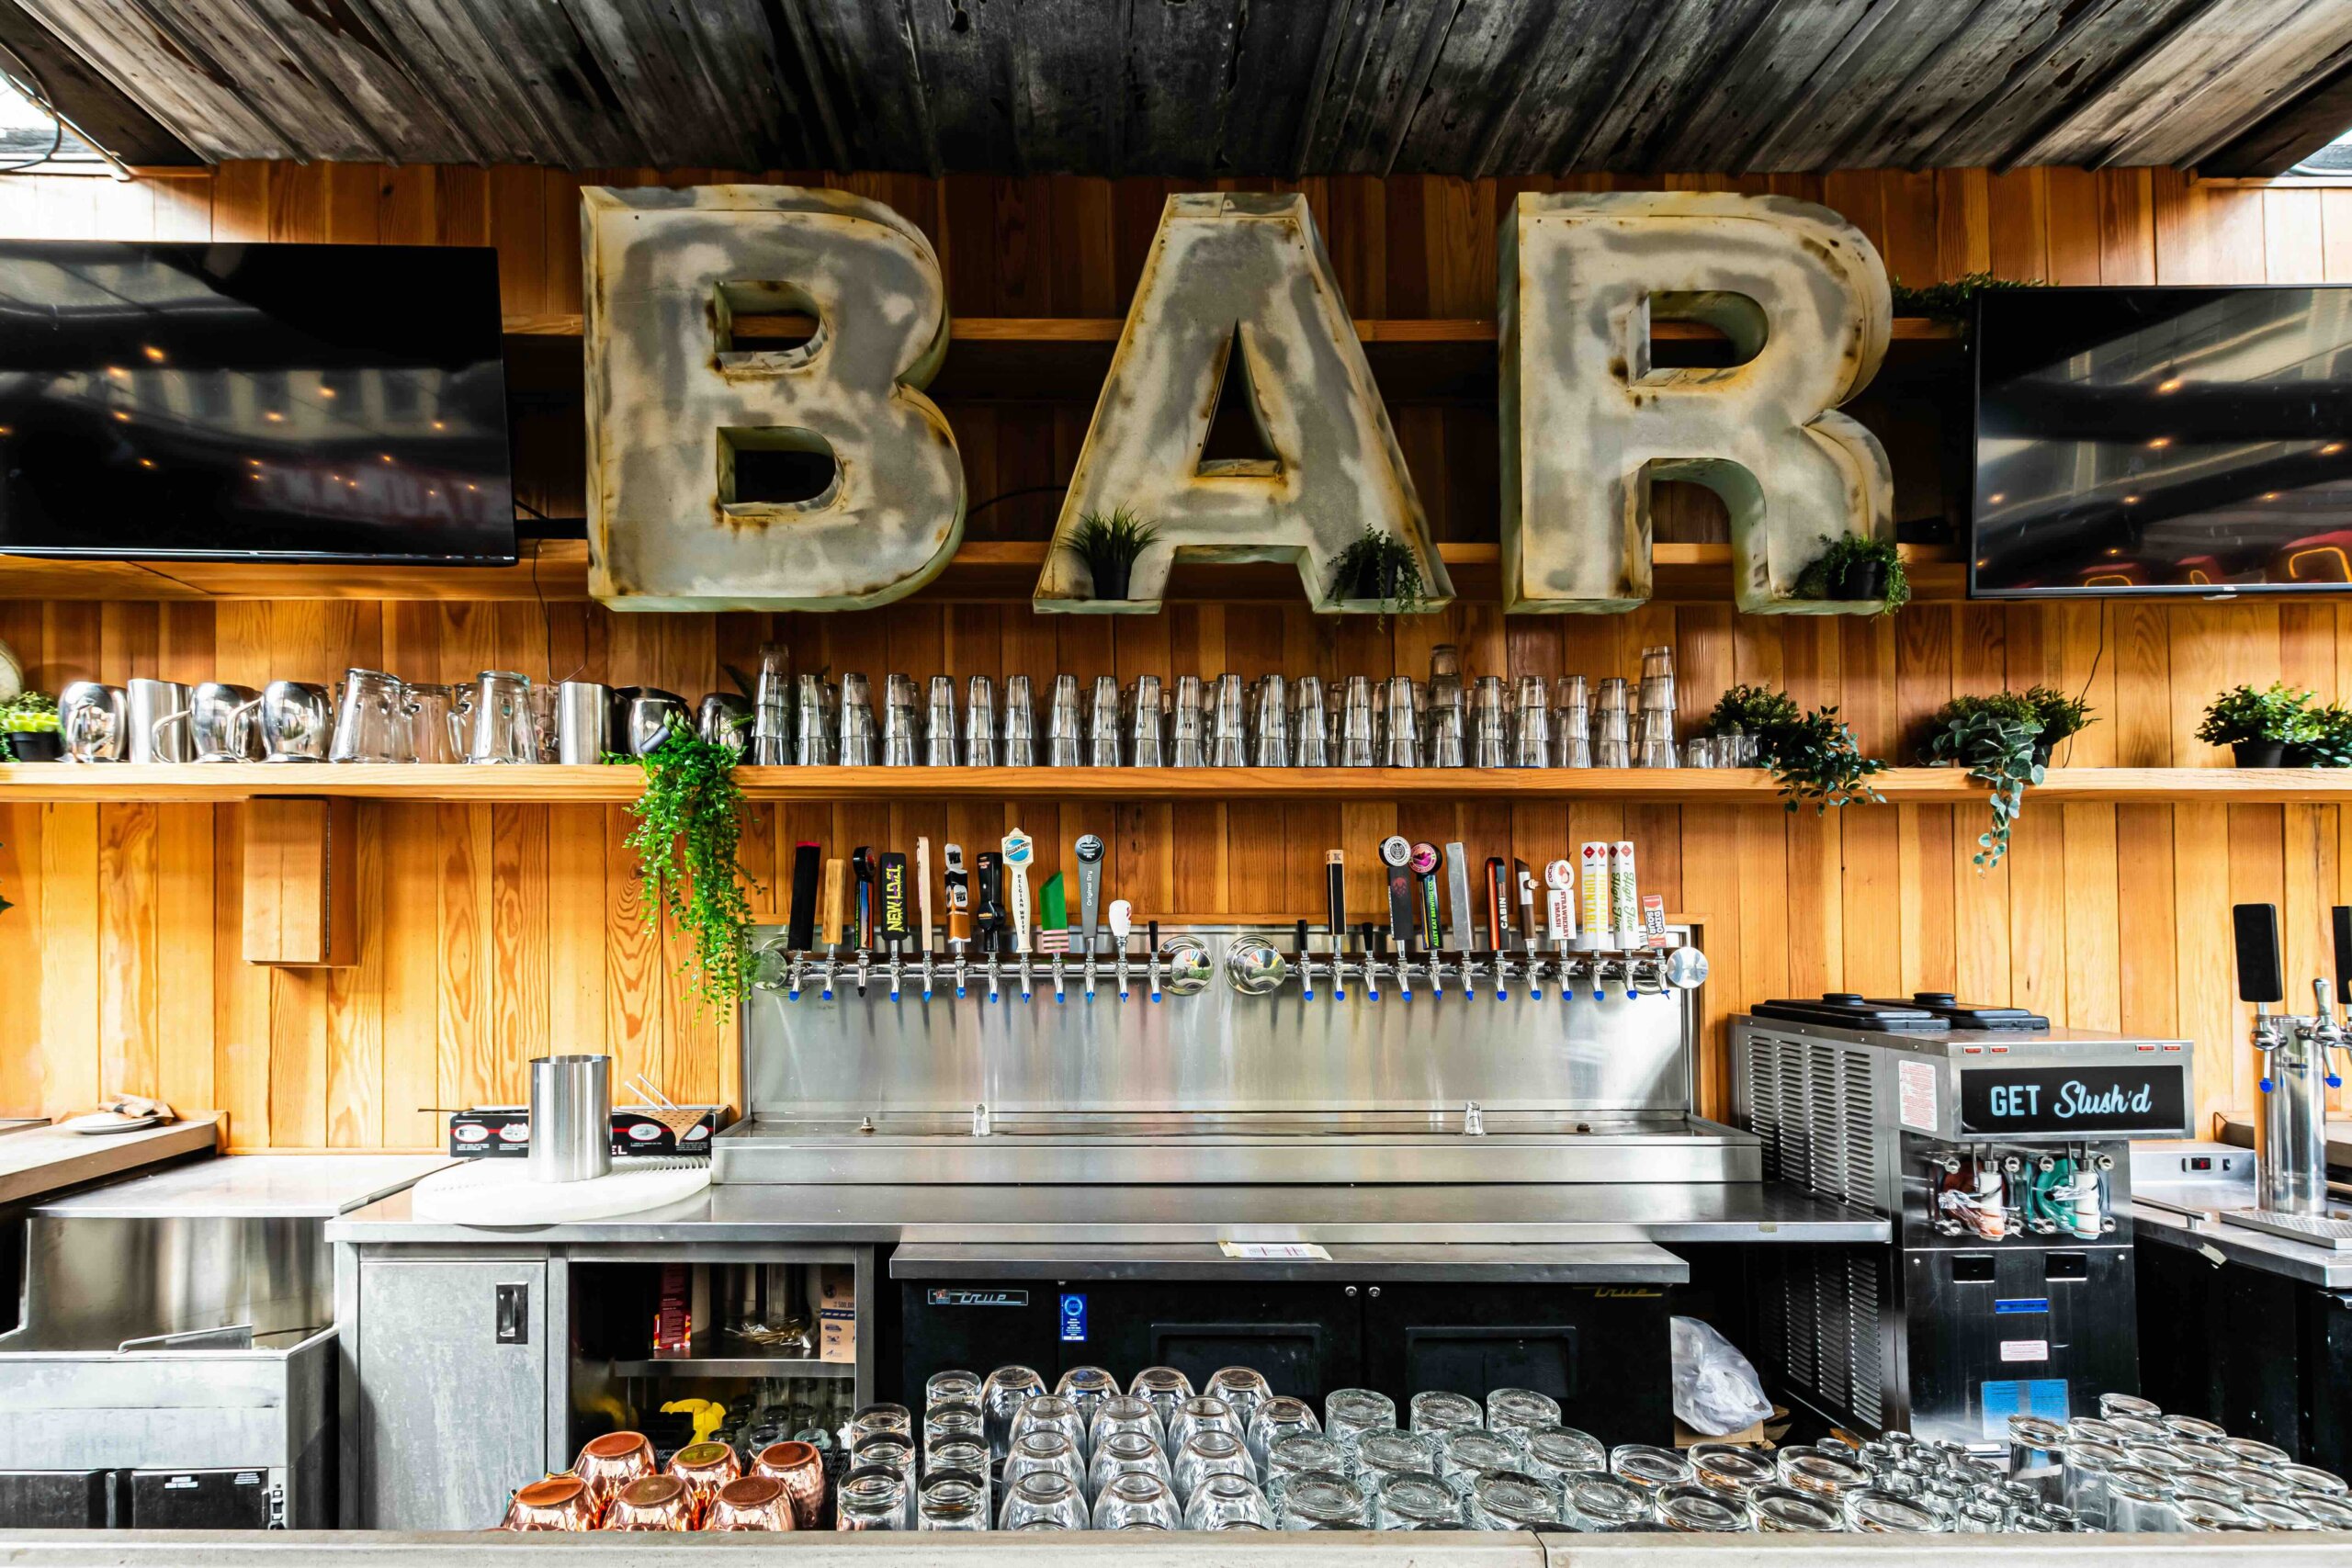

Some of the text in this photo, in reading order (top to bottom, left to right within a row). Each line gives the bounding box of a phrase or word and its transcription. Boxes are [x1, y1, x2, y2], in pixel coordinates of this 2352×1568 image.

[581, 184, 1898, 615] BAR
[886, 901, 905, 932] NEW
[1428, 890, 1436, 918] BREWING
[1498, 897, 1509, 930] CABIN
[1561, 891, 1569, 938] STRAWBERRY
[1583, 874, 1597, 934] TURNTABLE
[1646, 911, 1657, 935] SOUR
[1654, 910, 1664, 934] DINO
[1990, 1080, 2153, 1119] GET Slush'd
